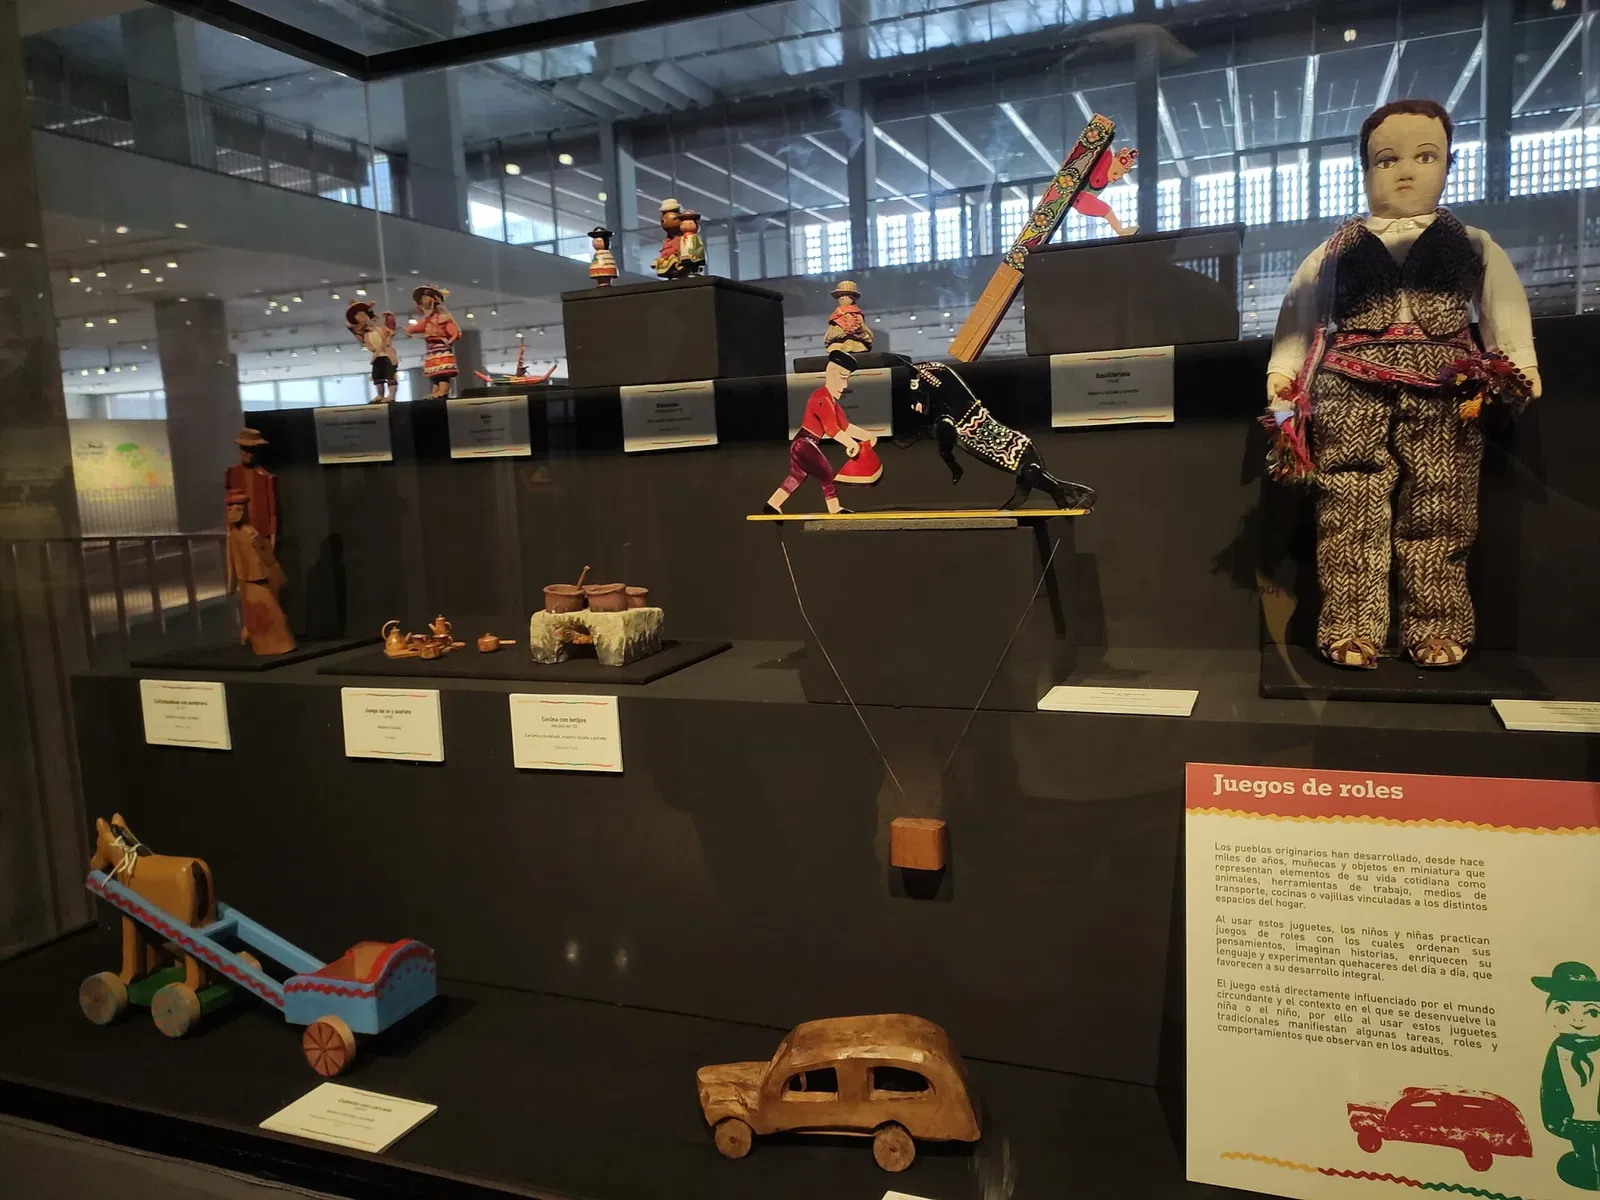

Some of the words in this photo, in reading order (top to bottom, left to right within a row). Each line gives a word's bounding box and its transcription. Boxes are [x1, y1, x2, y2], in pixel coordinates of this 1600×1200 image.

[1212, 773, 1295, 799] Juegos
[1301, 778, 1333, 796] de
[1339, 780, 1404, 800] roles
[1215, 842, 1231, 851] Los
[1235, 845, 1271, 854] pueblos
[1276, 847, 1327, 857] originarios
[1332, 850, 1349, 858] han
[1354, 852, 1421, 864] desarrollado,
[1425, 856, 1455, 865] desde
[1460, 857, 1484, 866] hace
[1215, 853, 1240, 862] miles
[1246, 855, 1256, 863] de
[1262, 856, 1287, 866] años,
[1293, 858, 1336, 868] muñecas
[1352, 862, 1387, 872] objetos
[1411, 866, 1460, 876] miniatura
[1466, 870, 1485, 878] que
[1215, 864, 1272, 875] representan
[1280, 868, 1330, 878] elementos
[1338, 872, 1349, 880] de
[1376, 874, 1396, 883] vida
[1404, 877, 1449, 887] cotidiana
[1458, 880, 1486, 888] como
[1215, 874, 1260, 885] animales,
[1272, 878, 1337, 890] herramientas
[1350, 883, 1361, 891] de
[1373, 885, 1411, 896] trabajo,
[1424, 889, 1461, 898] medios
[1474, 891, 1487, 900] de
[1216, 884, 1268, 896] transporte,
[1272, 889, 1307, 898] cocinas
[1320, 892, 1354, 902] vajillas
[1358, 894, 1411, 906] vinculadas
[1424, 899, 1439, 907] los
[1443, 900, 1487, 911] distintos
[1216, 895, 1256, 904] espacios
[1259, 898, 1273, 906] del
[1276, 899, 1306, 910] hogar.
[1216, 915, 1225, 923] Al
[1232, 918, 1252, 926] usar
[1259, 920, 1284, 928] estos
[1290, 921, 1334, 933] juguetes,
[1341, 925, 1355, 934] los
[1362, 927, 1388, 937] niños
[1395, 931, 1400, 939] y
[1407, 931, 1433, 940] niñas
[1441, 935, 1490, 945] practican
[1216, 925, 1247, 936] juegos
[1258, 929, 1269, 937] de
[1281, 932, 1305, 941] roles
[1345, 937, 1360, 946] los
[1372, 940, 1404, 949] cuales
[1417, 943, 1459, 954] ordenan
[1472, 948, 1491, 956] sus
[1216, 938, 1285, 951] pensamientos,
[1296, 943, 1340, 955] imaginan
[1351, 948, 1398, 960] historias,
[1409, 954, 1467, 966] enriquecen
[1479, 960, 1491, 968] su
[1216, 947, 1256, 959] lenguaje
[1260, 952, 1265, 960] y
[1268, 953, 1335, 965] experimentan
[1340, 960, 1398, 971] quehaceres
[1402, 964, 1417, 972] del
[1421, 965, 1436, 974] día
[1450, 968, 1468, 978] día,
[1473, 971, 1492, 980] que
[1217, 957, 1262, 970] favorecen
[1274, 964, 1285, 972] su
[1288, 964, 1339, 977] desarrollo
[1342, 969, 1384, 981] integral.
[1217, 979, 1226, 988] El
[1230, 980, 1256, 992] juego
[1260, 984, 1280, 993] está
[1285, 986, 1350, 1000] directamente
[1354, 992, 1416, 1006] influenciado
[1421, 1000, 1438, 1009] por
[1444, 1002, 1453, 1010] el
[1458, 1004, 1495, 1015] mundo
[1217, 990, 1273, 1003] circundante
[1277, 997, 1282, 1005] y
[1299, 999, 1341, 1010] contexto
[1362, 1005, 1371, 1013] el
[1375, 1007, 1393, 1016] que
[1398, 1009, 1410, 1017] se
[1415, 1010, 1480, 1025] desenvuelve
[1486, 1017, 1496, 1026] la
[1217, 1001, 1237, 1010] niña
[1260, 1006, 1268, 1014] el
[1277, 1008, 1300, 1018] niño,
[1309, 1012, 1325, 1020] por
[1334, 1014, 1353, 1023] ello
[1362, 1016, 1371, 1025] al
[1380, 1019, 1403, 1028] usar
[1413, 1022, 1441, 1032] estos
[1450, 1025, 1497, 1039] juguetes
[1217, 1012, 1279, 1026] tradicionales
[1289, 1020, 1346, 1033] manifiestan
[1356, 1027, 1397, 1039] algunas
[1406, 1033, 1443, 1045] tareas,
[1454, 1038, 1482, 1048] roles
[1492, 1043, 1497, 1052] y
[1217, 1024, 1302, 1040] comportamientos
[1305, 1034, 1323, 1043] que
[1326, 1035, 1373, 1048] observan
[1376, 1041, 1388, 1049] en
[1392, 1042, 1407, 1051] los
[1410, 1045, 1452, 1057] adultos.
